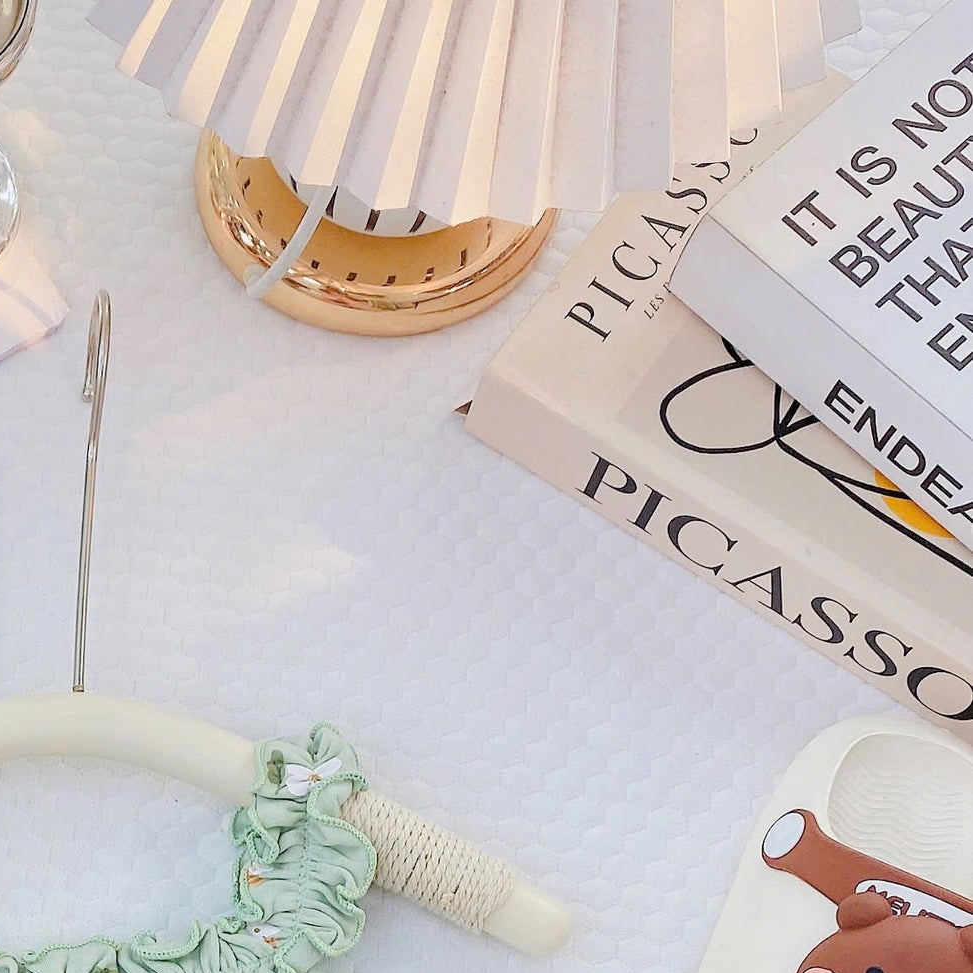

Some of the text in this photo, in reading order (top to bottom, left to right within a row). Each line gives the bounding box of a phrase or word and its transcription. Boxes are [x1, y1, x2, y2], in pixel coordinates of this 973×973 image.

[782, 190, 837, 247] IT
[835, 146, 897, 199] IS
[828, 135, 973, 288] BEAUT
[643, 293, 666, 320] LES
[575, 450, 973, 721] PICASSO
